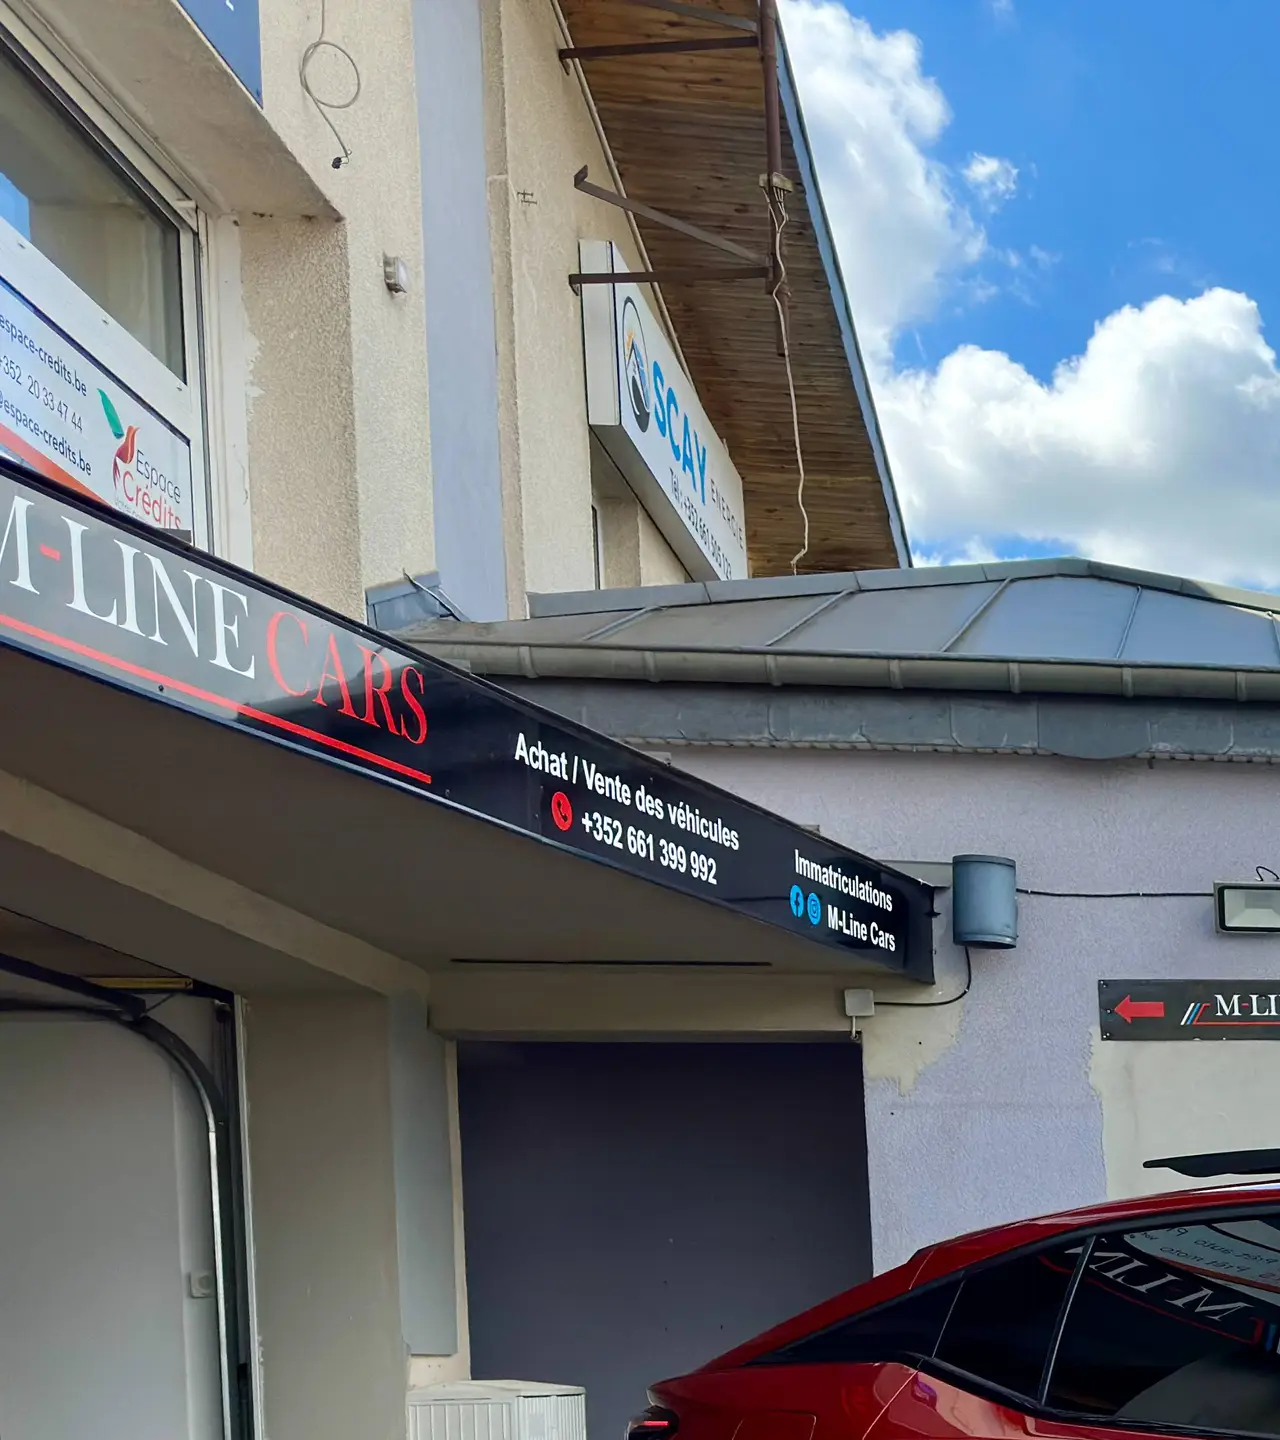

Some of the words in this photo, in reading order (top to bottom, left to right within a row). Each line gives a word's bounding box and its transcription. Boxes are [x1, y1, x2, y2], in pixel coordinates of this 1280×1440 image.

[0, 354, 22, 386] 352
[27, 375, 40, 400] 20
[42, 386, 55, 411] 33
[57, 400, 68, 423] 47
[71, 411, 83, 433] 44
[652, 360, 706, 505] SCAY
[136, 450, 181, 504] Espace
[267, 611, 429, 744] CARS
[514, 732, 568, 783] Achat
[572, 756, 578, 784] /
[582, 759, 631, 806] Vente
[635, 785, 664, 820] des
[668, 801, 739, 851] véhicules
[581, 811, 623, 850] +352
[627, 826, 654, 861] 661
[659, 839, 687, 874] 399
[690, 850, 718, 885] 992
[794, 848, 893, 913] Immatriculations
[827, 903, 867, 941] M-Line
[869, 924, 896, 952] Cars
